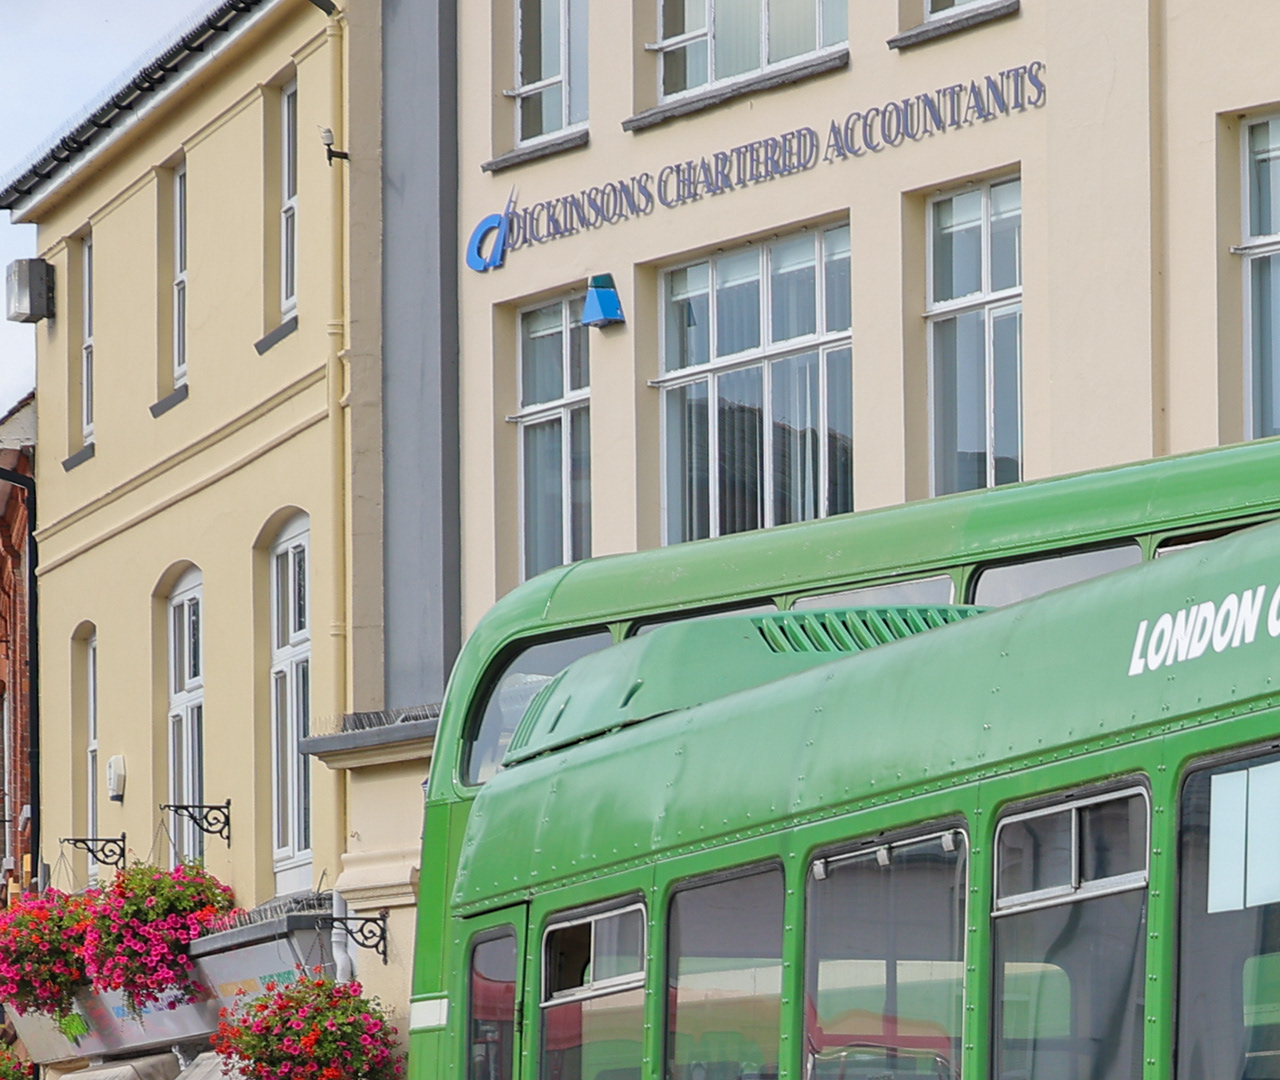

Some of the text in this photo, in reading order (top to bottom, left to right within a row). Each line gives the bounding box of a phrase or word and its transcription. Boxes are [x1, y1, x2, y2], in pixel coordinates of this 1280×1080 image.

[503, 172, 652, 250] DICKINSONS
[656, 126, 819, 209] CHARTERED
[823, 60, 1045, 163] ACCOUNTANTS
[1128, 584, 1267, 676] LONDON
